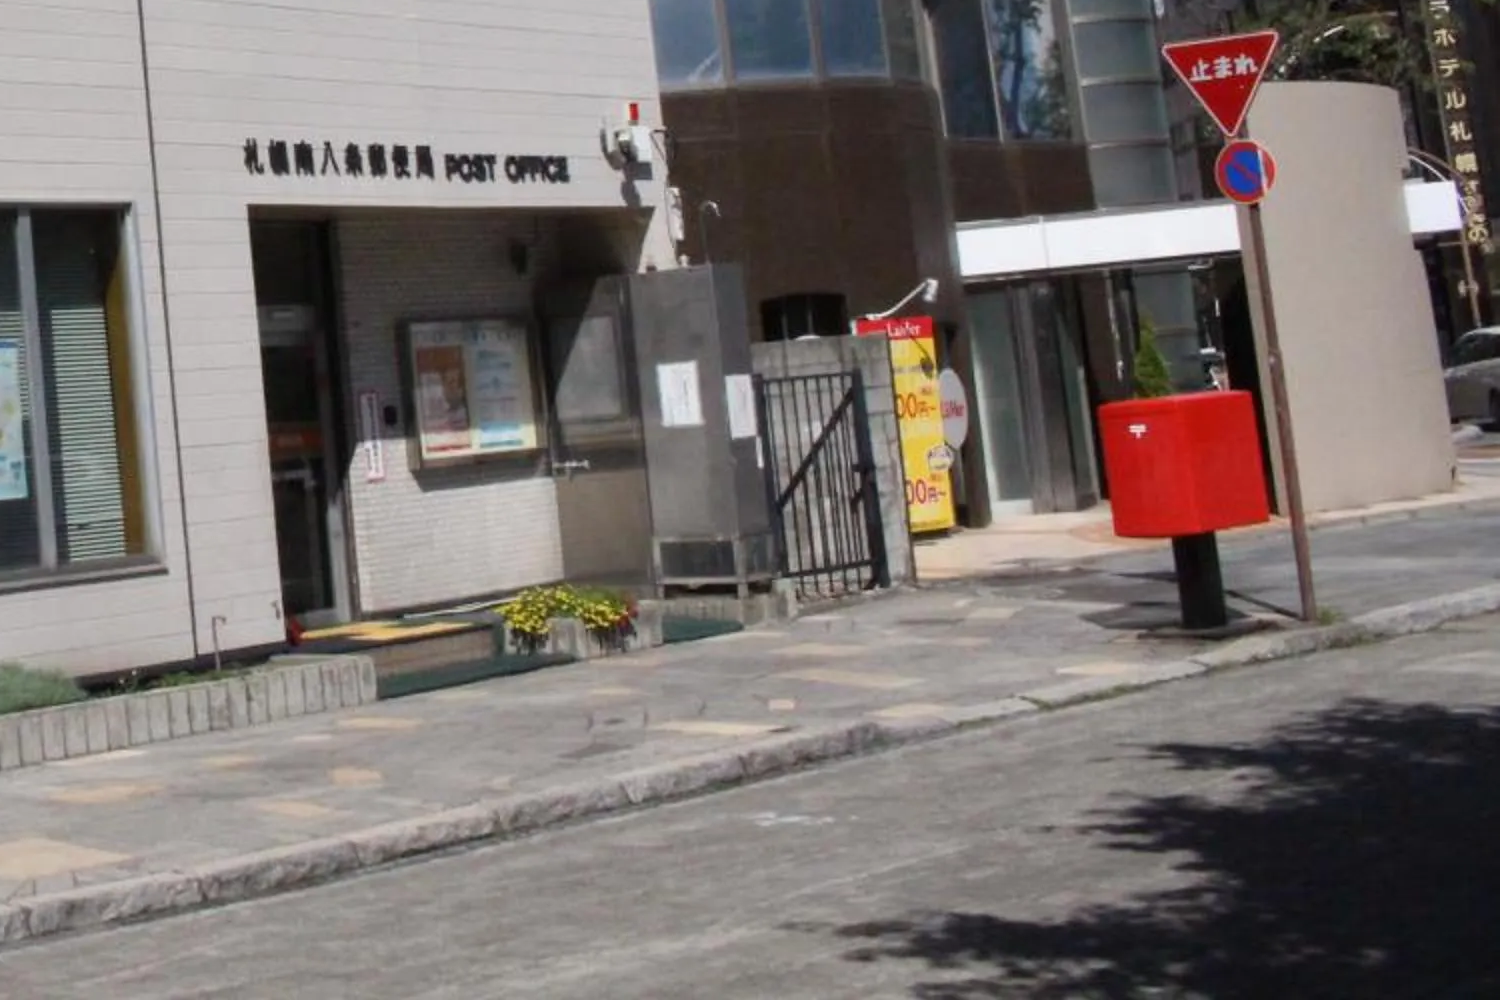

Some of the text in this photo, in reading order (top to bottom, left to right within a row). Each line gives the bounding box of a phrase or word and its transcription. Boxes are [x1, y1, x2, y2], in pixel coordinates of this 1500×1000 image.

[1190, 53, 1258, 82] 止まれ
[444, 153, 497, 183] POST
[504, 154, 571, 183] OFFICE
